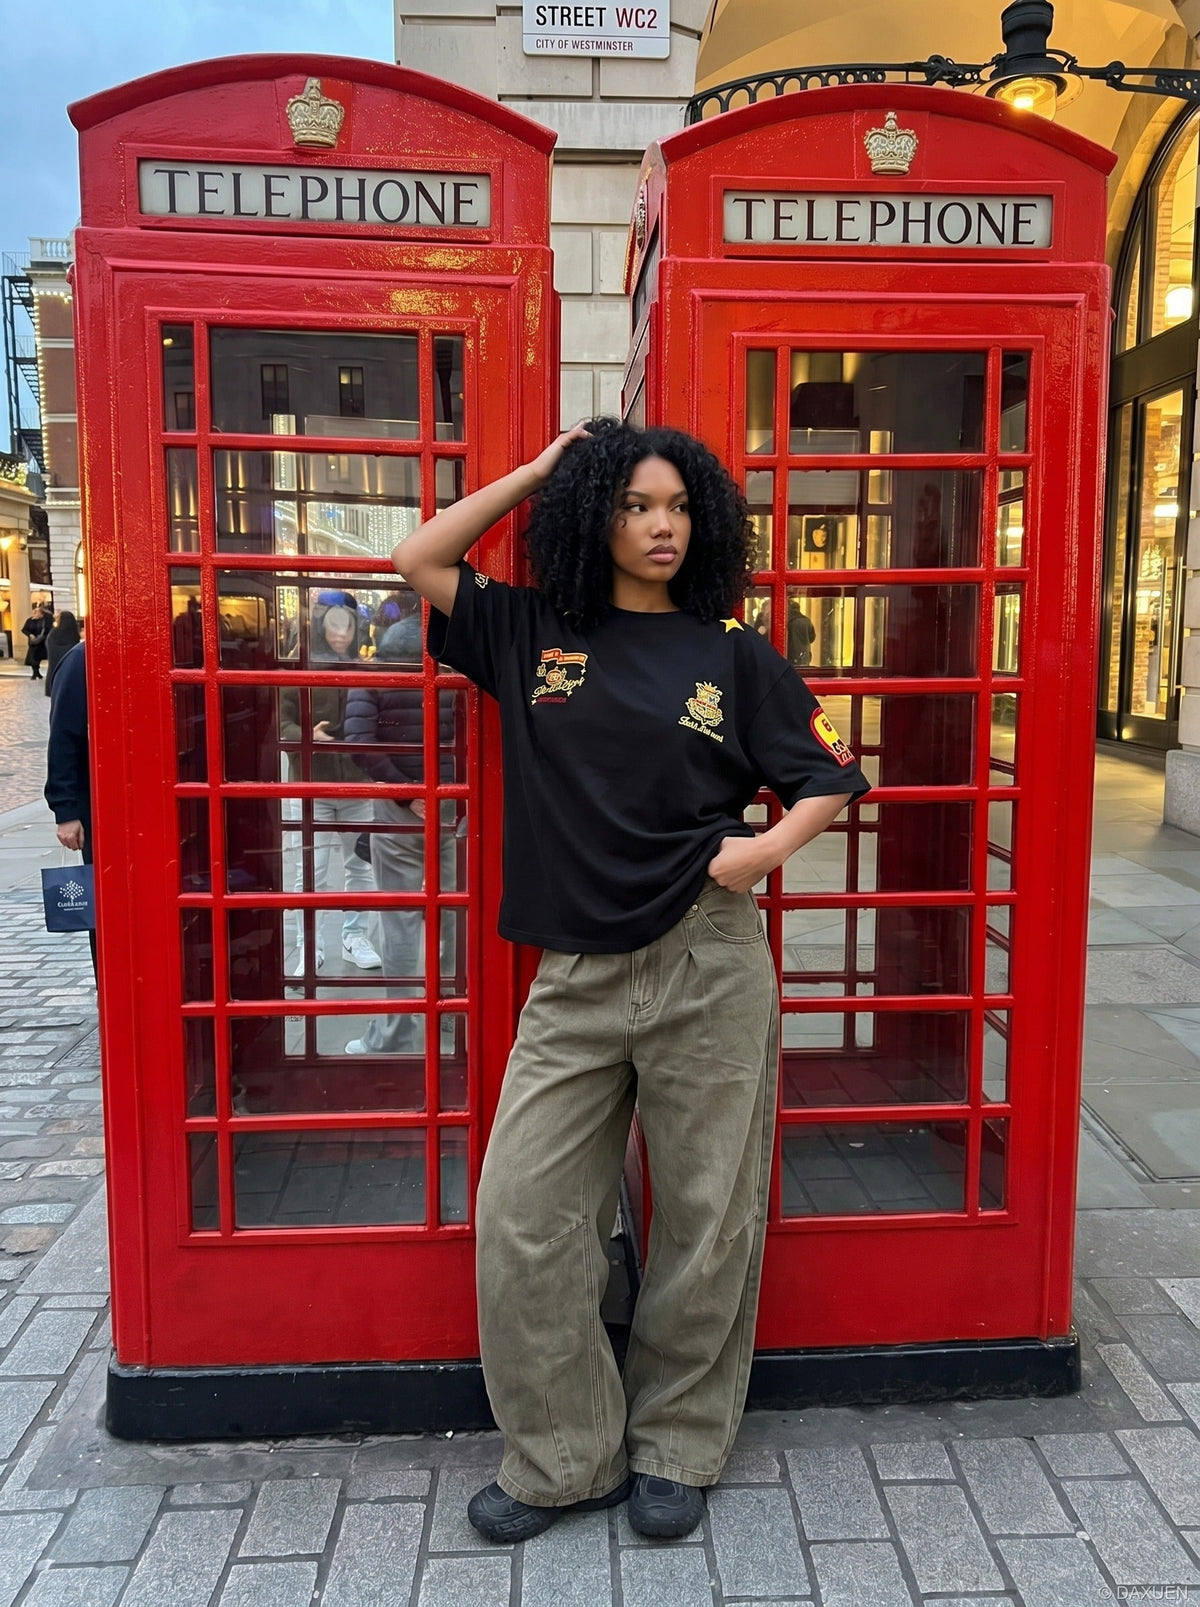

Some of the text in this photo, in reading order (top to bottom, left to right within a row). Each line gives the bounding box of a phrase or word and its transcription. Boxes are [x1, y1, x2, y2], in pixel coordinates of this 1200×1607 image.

[536, 5, 658, 29] STREET WC2
[536, 38, 634, 51] CITY OF WESTMINSTER
[153, 168, 479, 226] TELEPHONE
[732, 197, 1038, 246] TELEPHONE
